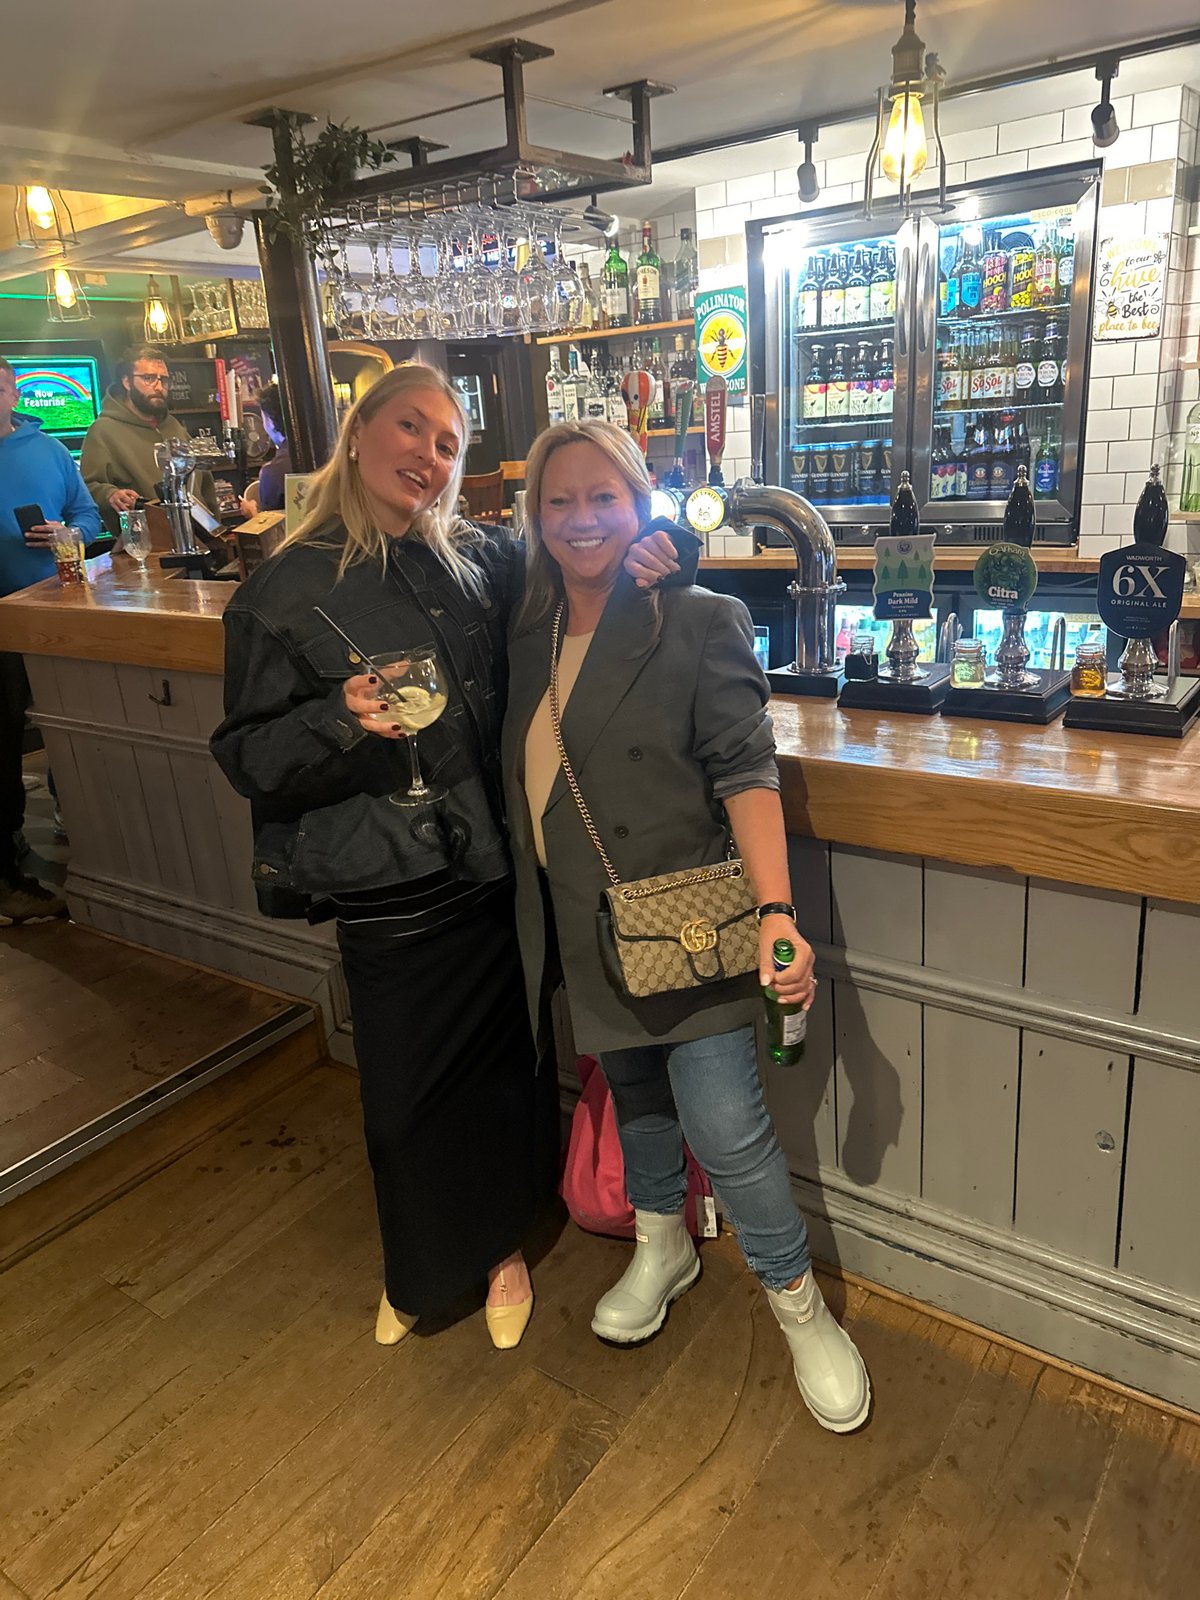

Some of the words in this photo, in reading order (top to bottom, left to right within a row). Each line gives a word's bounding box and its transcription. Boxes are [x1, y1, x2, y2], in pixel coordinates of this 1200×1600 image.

[1125, 256, 1135, 267] to
[1136, 255, 1152, 263] our
[1129, 290, 1144, 303] the
[696, 293, 746, 320] POLLINATOR
[1121, 302, 1149, 318] Best
[1098, 320, 1125, 336] place
[1127, 319, 1138, 330] to
[972, 376, 984, 393] SO
[34, 389, 54, 398] Now
[24, 397, 66, 408] Featuring
[711, 392, 720, 442] AMSTEL
[1112, 564, 1171, 599] 6X
[988, 586, 1018, 599] Citra
[1110, 599, 1149, 607] ORIGINAL
